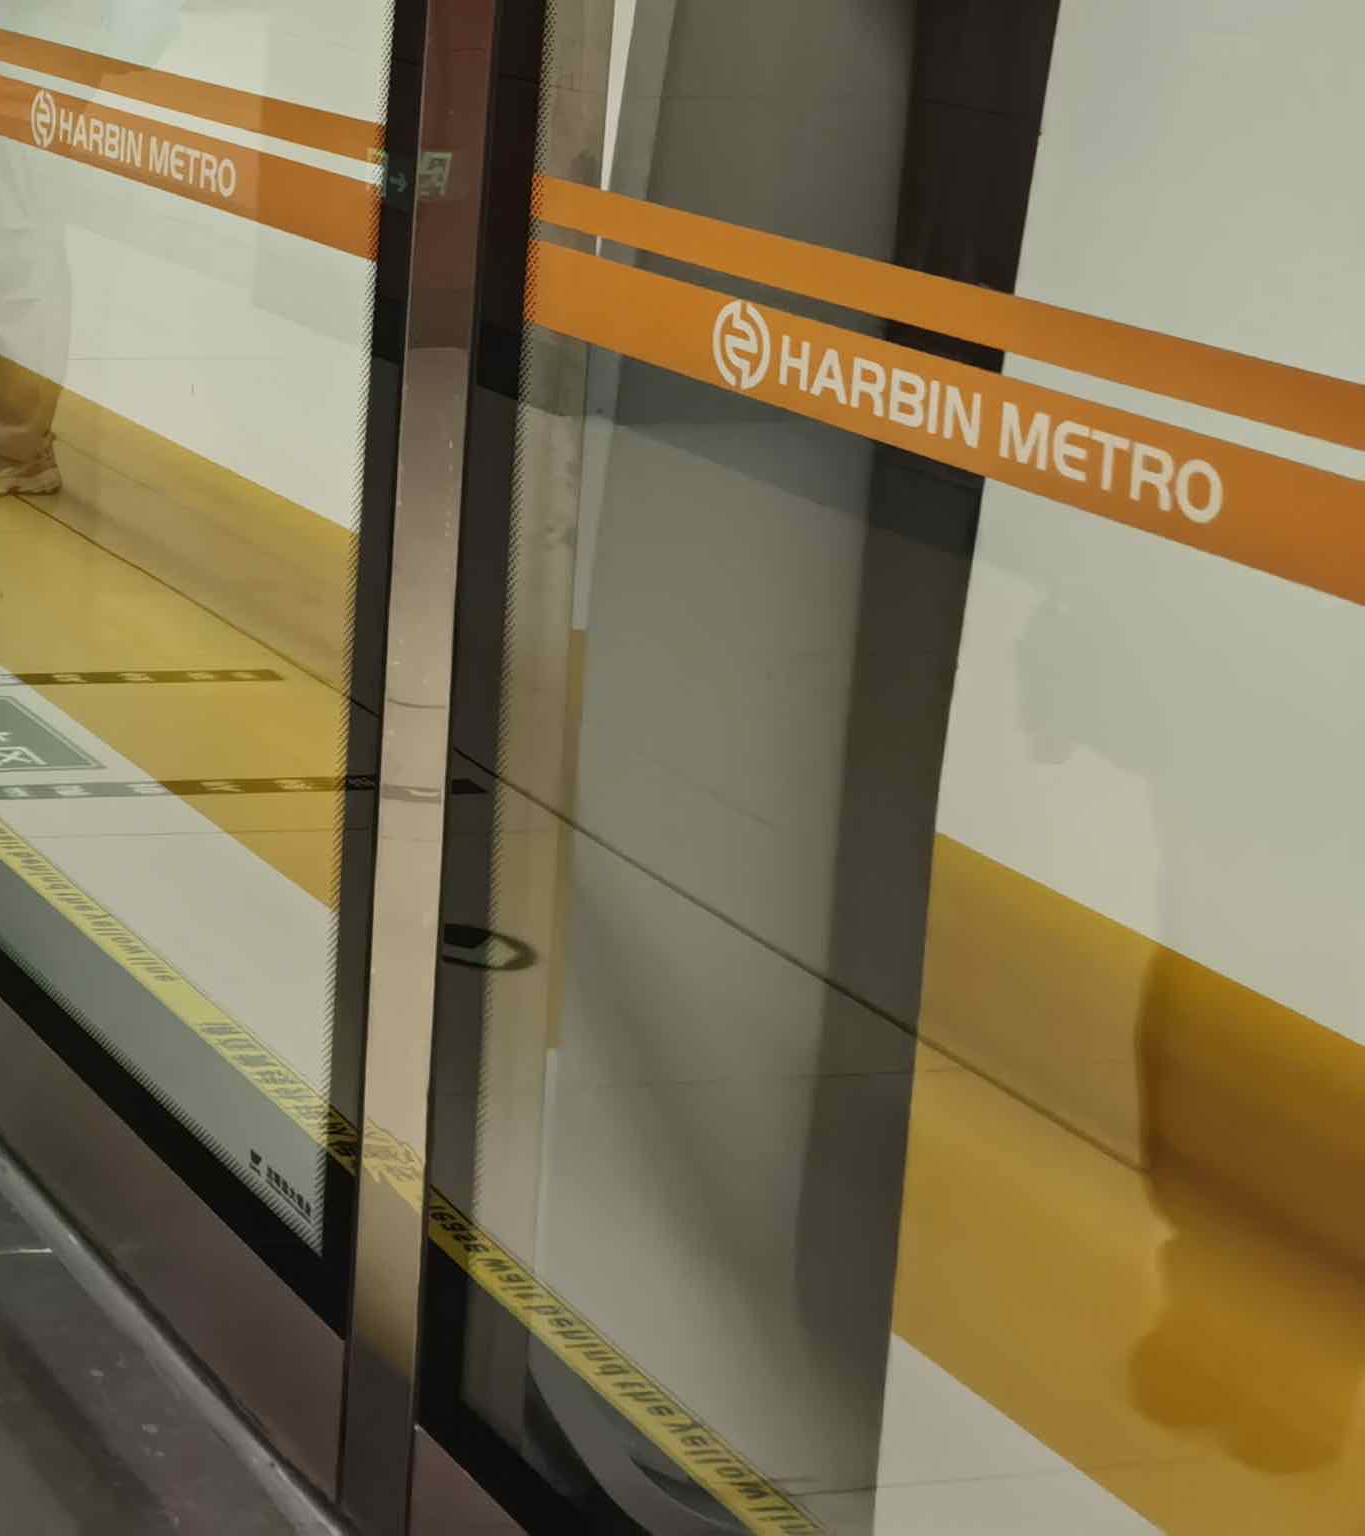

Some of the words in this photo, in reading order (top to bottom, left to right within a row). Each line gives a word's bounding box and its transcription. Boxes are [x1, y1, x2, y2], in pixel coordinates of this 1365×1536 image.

[59, 107, 142, 167] HARBIN
[148, 137, 236, 198] METRO
[778, 334, 983, 449] HARBIN
[999, 403, 1223, 524] METRO
